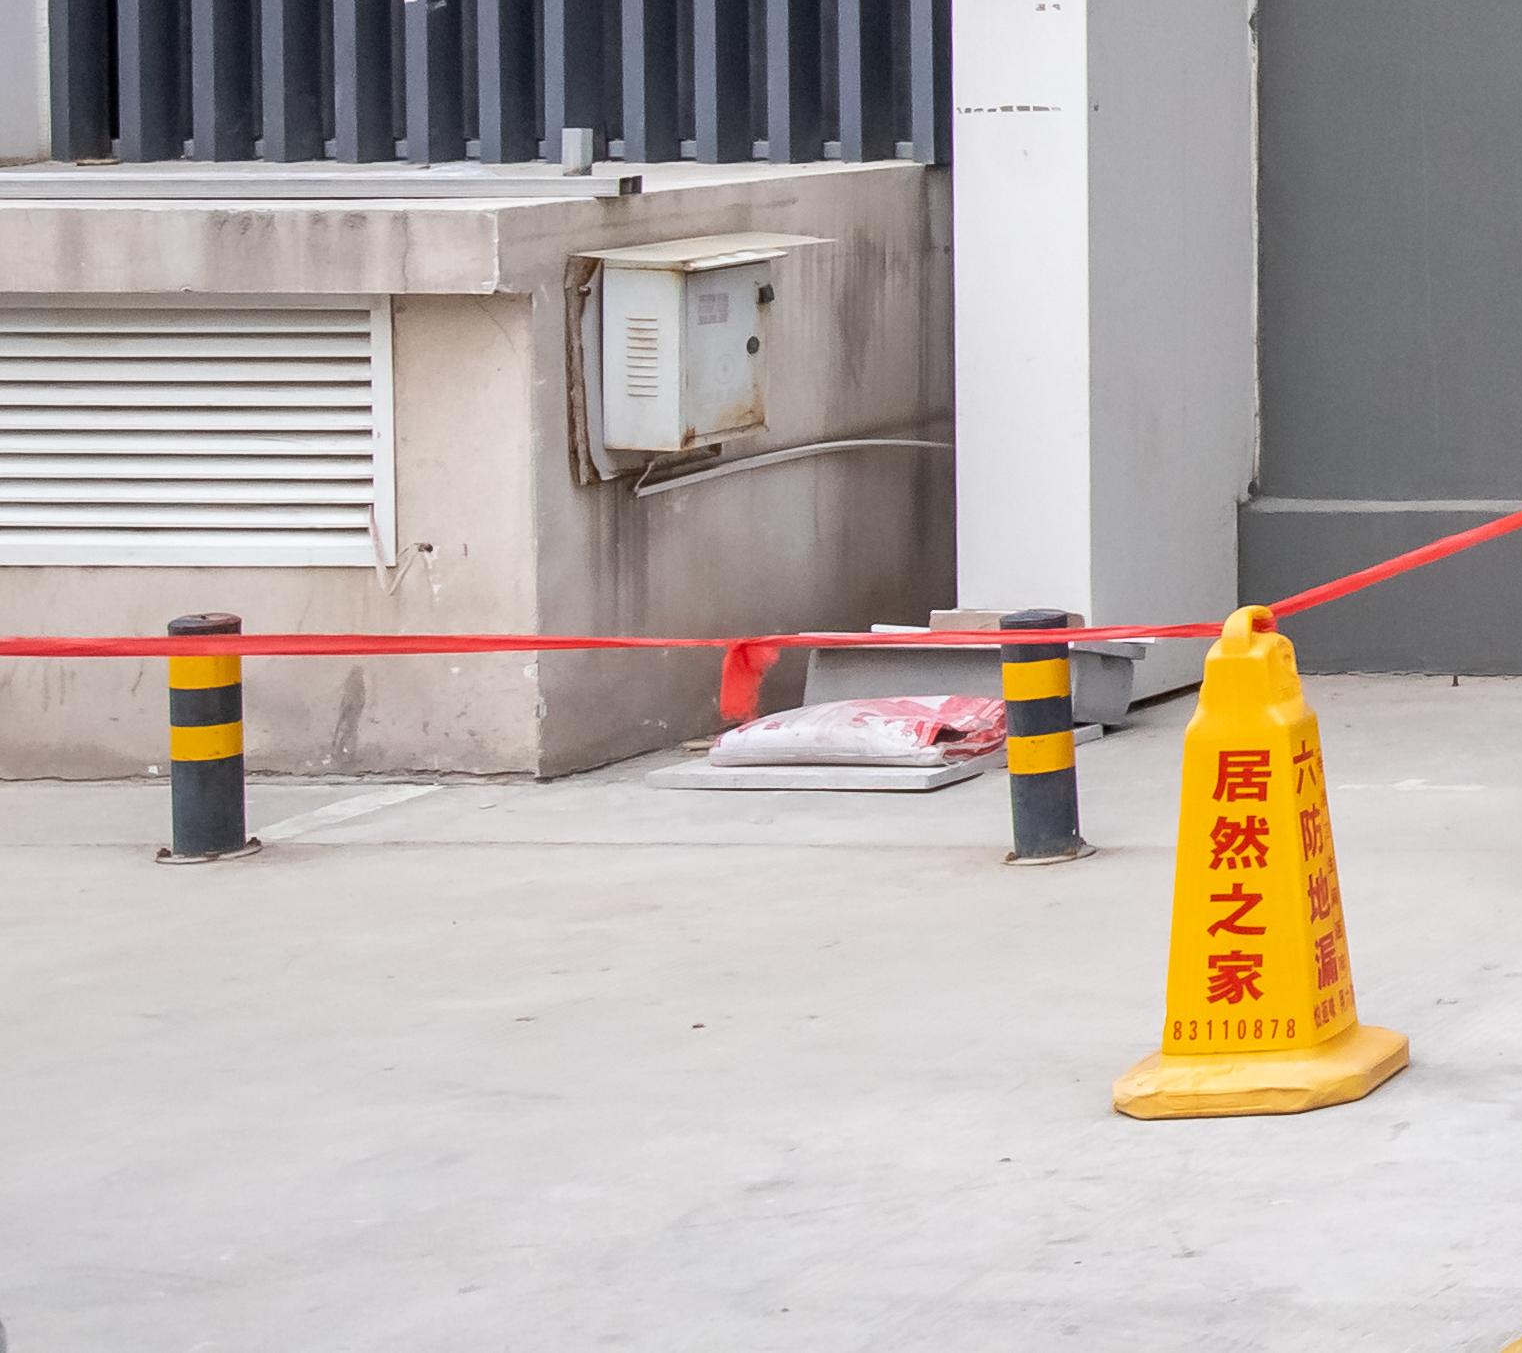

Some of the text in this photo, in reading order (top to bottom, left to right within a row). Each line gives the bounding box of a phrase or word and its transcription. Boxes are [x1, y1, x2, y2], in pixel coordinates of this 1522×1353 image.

[1206, 749, 1273, 1005] 居然之家
[1292, 739, 1339, 991] 六防地漏
[1172, 1018, 1296, 1041] 83110878
